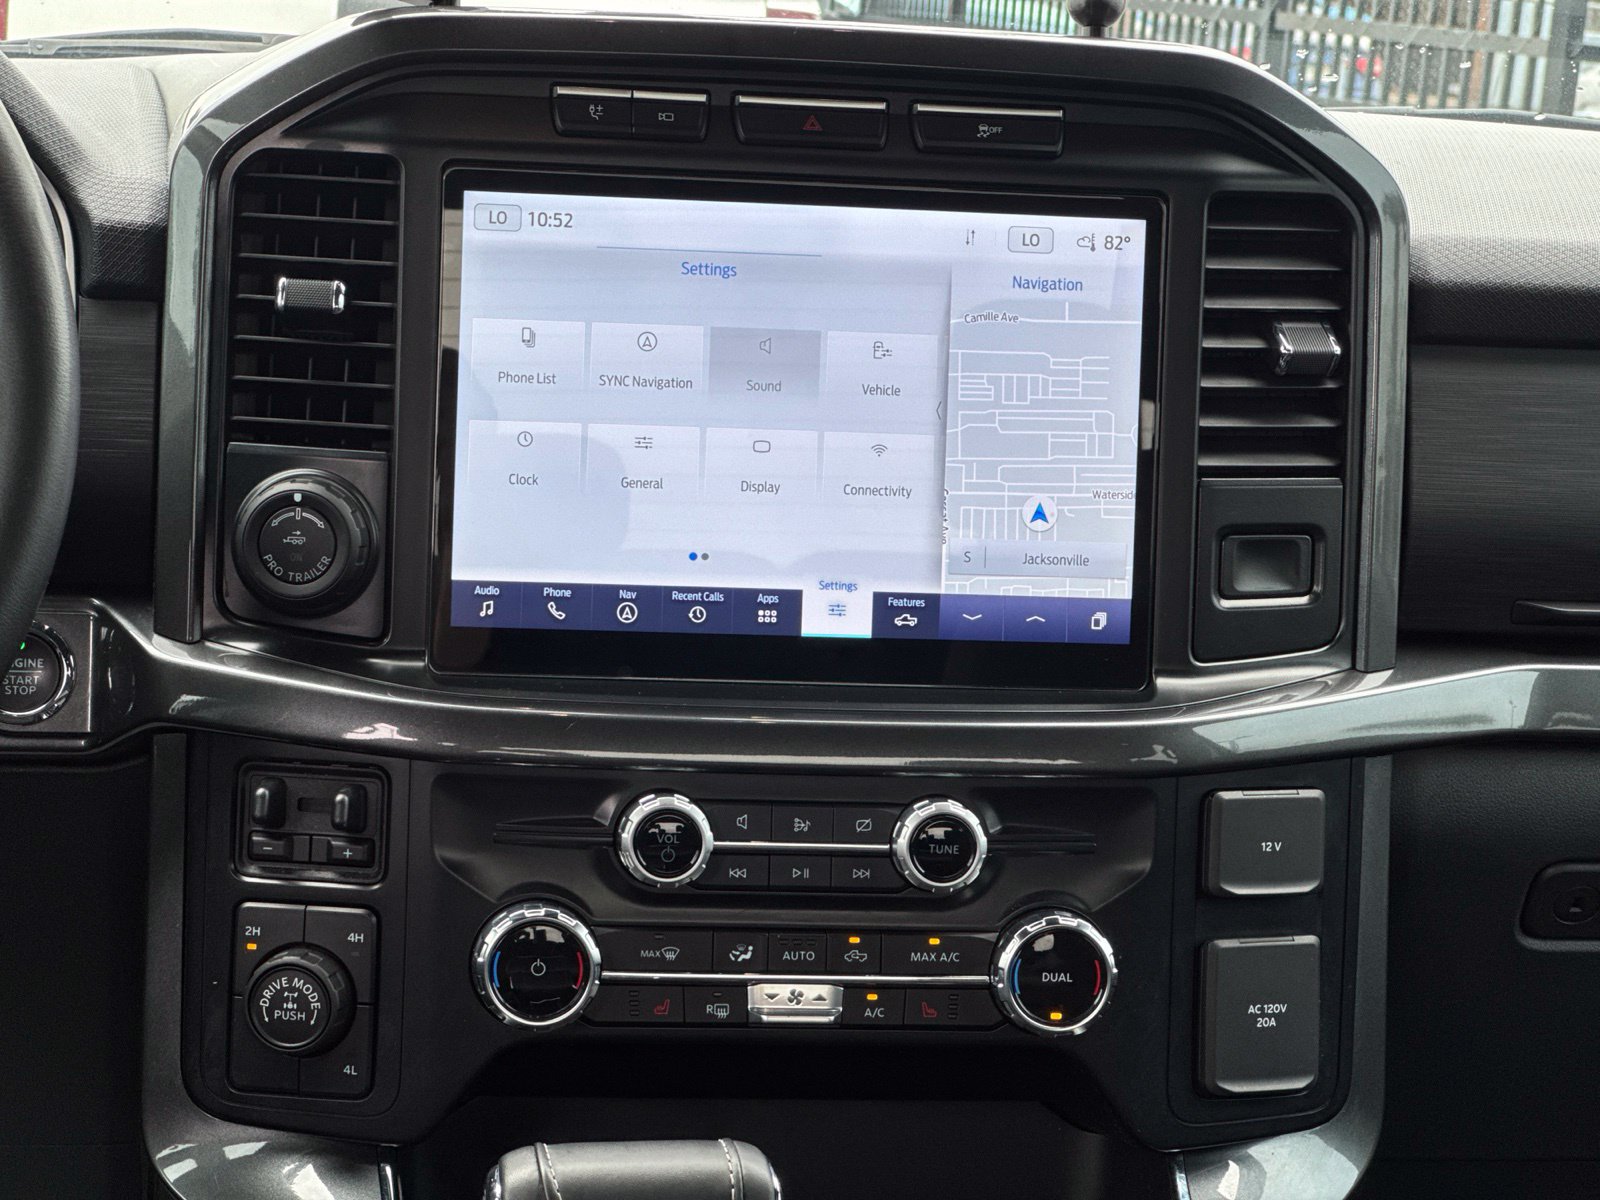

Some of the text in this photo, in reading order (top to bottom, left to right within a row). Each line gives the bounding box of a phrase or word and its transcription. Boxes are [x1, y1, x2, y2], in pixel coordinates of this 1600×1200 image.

[988, 126, 1003, 134] OFF
[489, 210, 508, 225] LO
[528, 211, 573, 228] 10:52
[1022, 233, 1041, 247] LO
[1104, 235, 1131, 250] 82°
[681, 261, 737, 279] Settings
[1012, 275, 1083, 292] Navigation
[964, 313, 1019, 324] Camille Ave
[498, 371, 556, 385] Phone List
[599, 375, 693, 389] SYNC Navigation
[746, 379, 782, 392] Sound
[862, 384, 901, 397] Vehicle
[509, 473, 539, 486] Clock
[621, 477, 663, 490] General
[741, 481, 780, 495] Display
[843, 484, 912, 499] Connectivity
[1092, 490, 1136, 500] Watersid
[963, 551, 971, 564] S
[1022, 552, 1090, 567] Jacksonville
[263, 554, 331, 582] PRO TRAILER
[474, 585, 500, 596] Audio
[543, 587, 572, 597] Phone
[819, 580, 857, 593] Settings
[619, 590, 637, 599] Nav
[671, 591, 724, 602] Recent Calls
[757, 594, 779, 605] Apps
[888, 597, 925, 608] Features
[11, 658, 45, 668] GINE
[2, 675, 40, 685] START
[4, 685, 37, 695] STOP
[657, 835, 680, 844] VOL
[929, 844, 959, 855] TUNE
[245, 926, 261, 936] 2H
[347, 933, 364, 943] 4H
[641, 950, 661, 959] MAX
[782, 951, 815, 961] AUTO
[910, 952, 960, 963] MAX A/C
[1042, 972, 1073, 983] DUAL
[259, 977, 321, 1009] DRIVE MODE
[864, 1007, 885, 1018] A/C
[1247, 1003, 1287, 1014] AC 120V
[274, 1010, 306, 1021] PUSH
[1256, 1018, 1277, 1028] 20A
[343, 1065, 357, 1075] 4L
